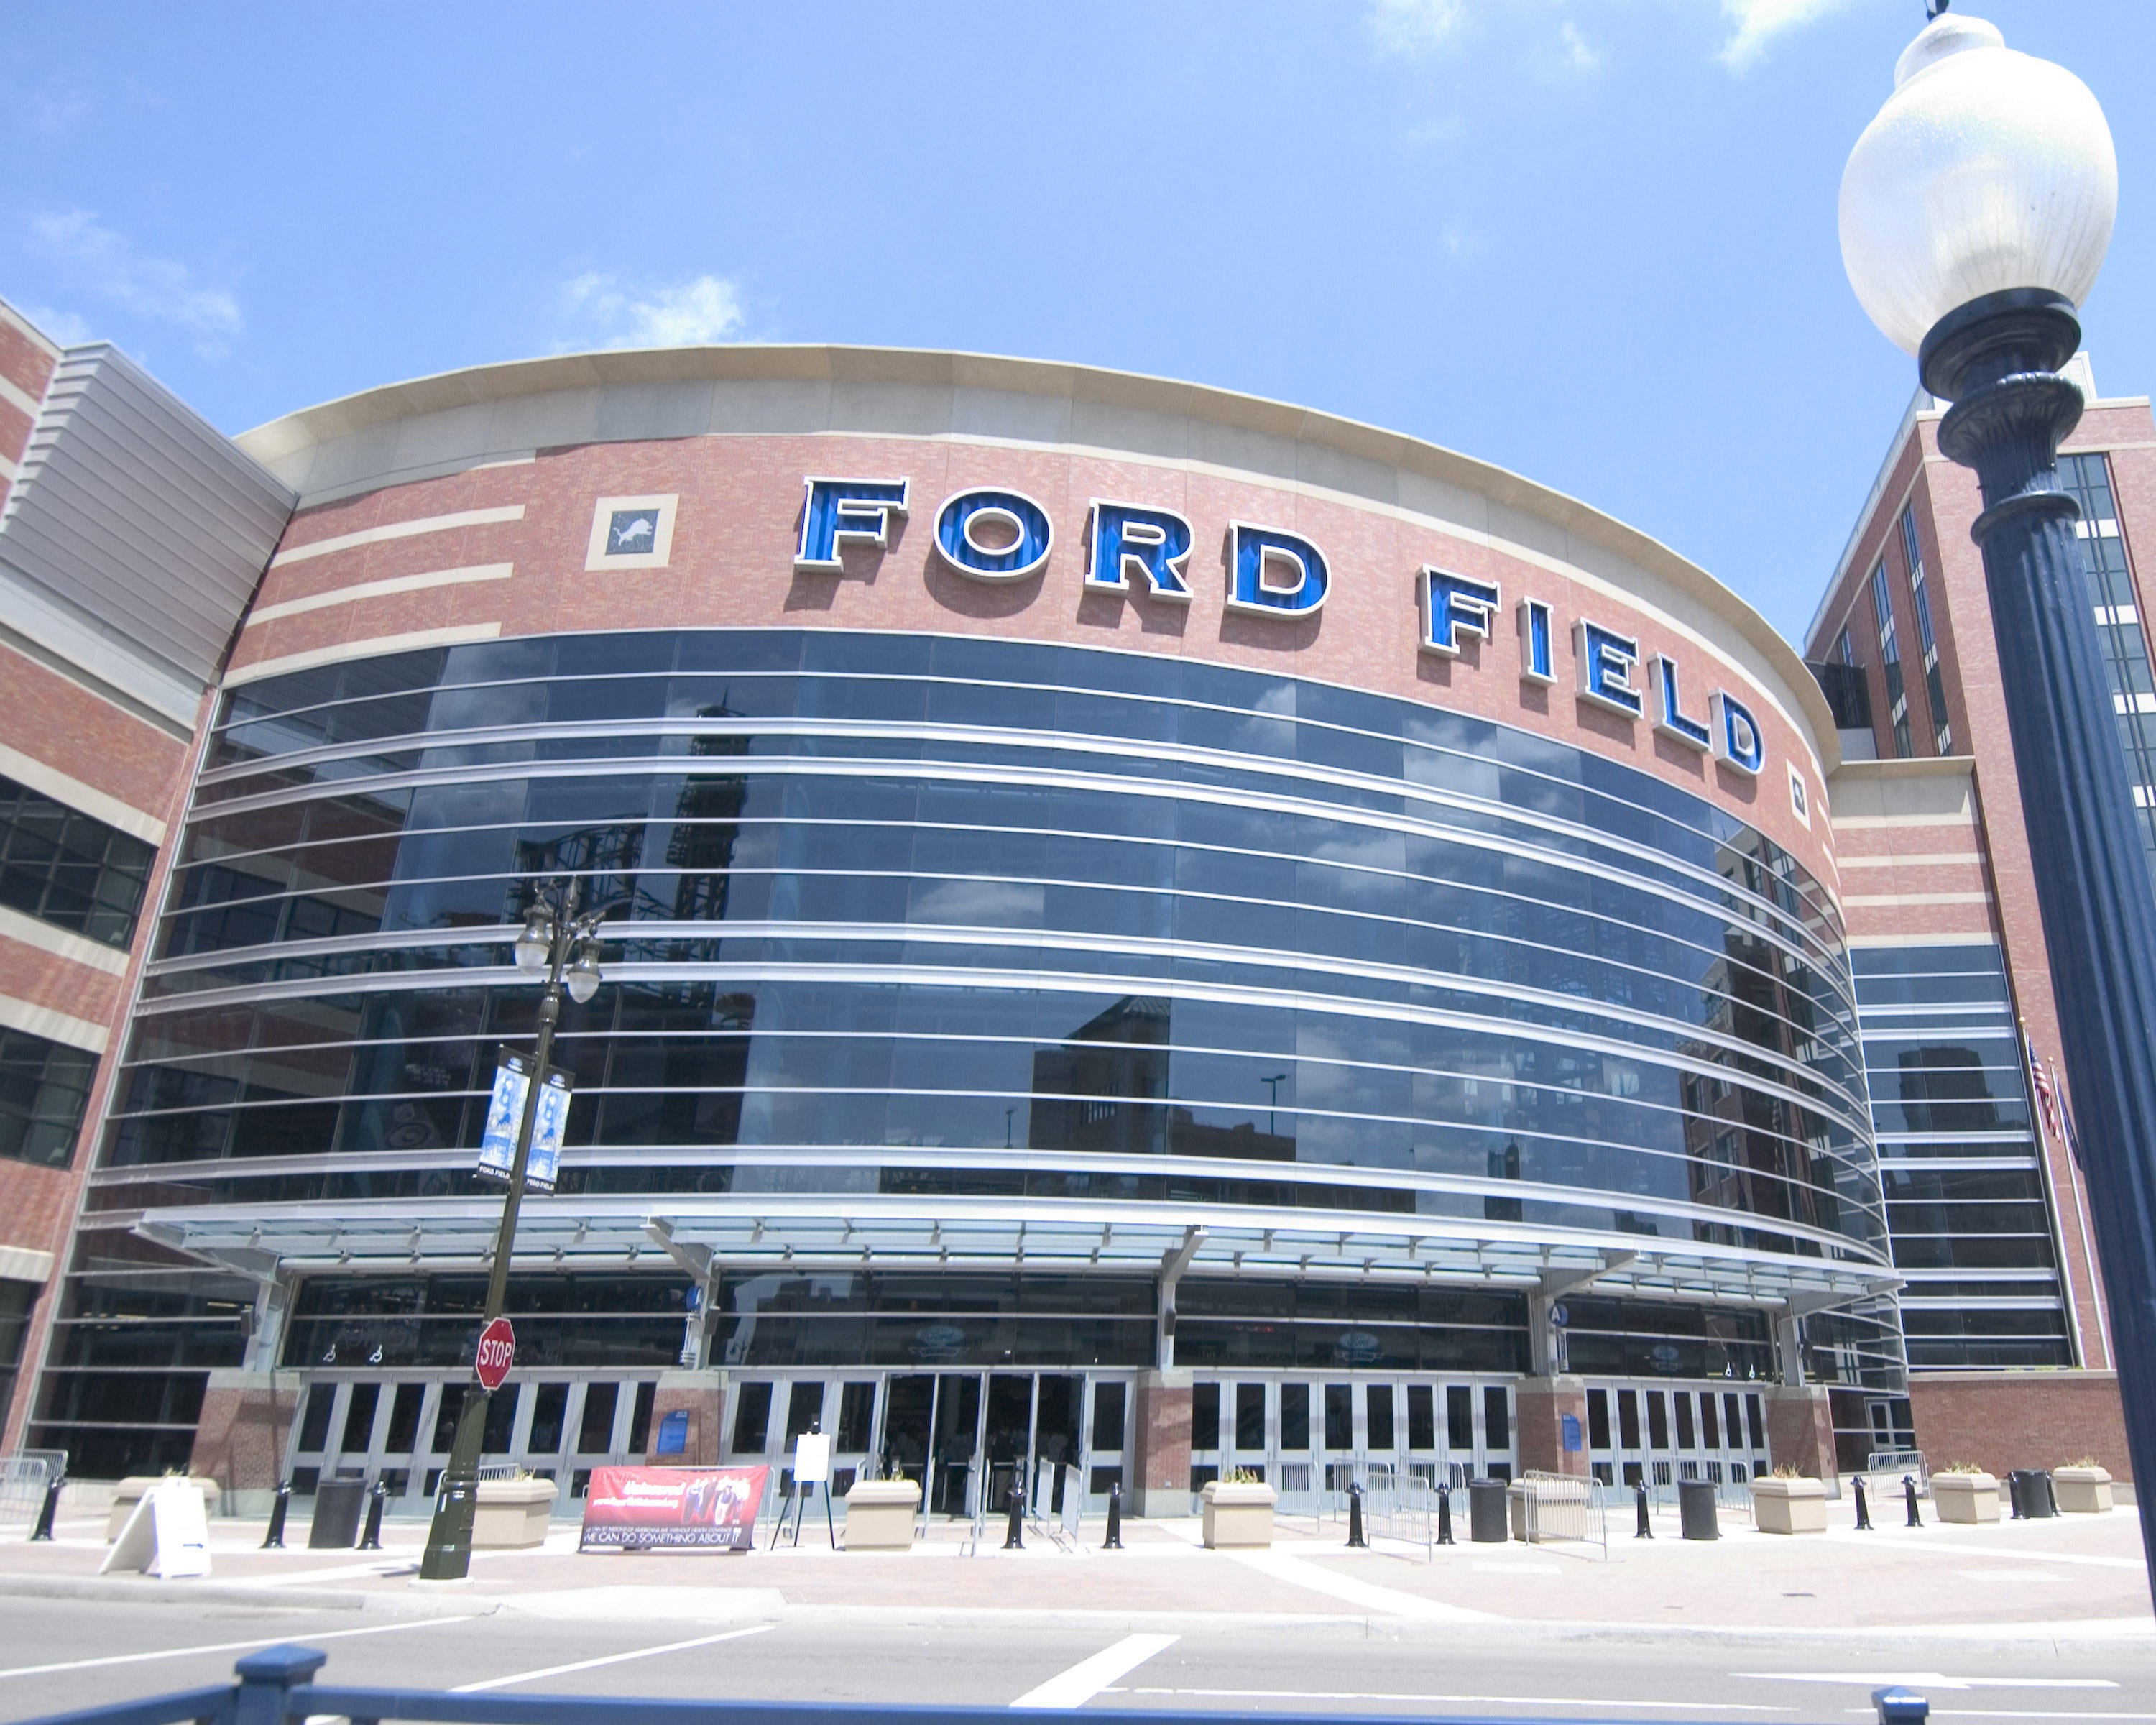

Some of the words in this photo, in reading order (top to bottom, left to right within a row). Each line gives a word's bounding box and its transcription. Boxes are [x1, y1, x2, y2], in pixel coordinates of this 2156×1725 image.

[793, 475, 1332, 618] FORD
[1416, 563, 1766, 776] FIELD
[479, 1165, 494, 1175] FORD
[494, 1169, 510, 1179] FIELD
[1551, 1305, 1561, 1322] A
[480, 1339, 512, 1367] STOP
[584, 1532, 596, 1542] WE
[598, 1532, 619, 1543] CAN
[622, 1532, 637, 1543] DO
[638, 1532, 696, 1544] SOMETHING
[697, 1532, 731, 1544] ABOUT
[732, 1532, 740, 1544] IT
